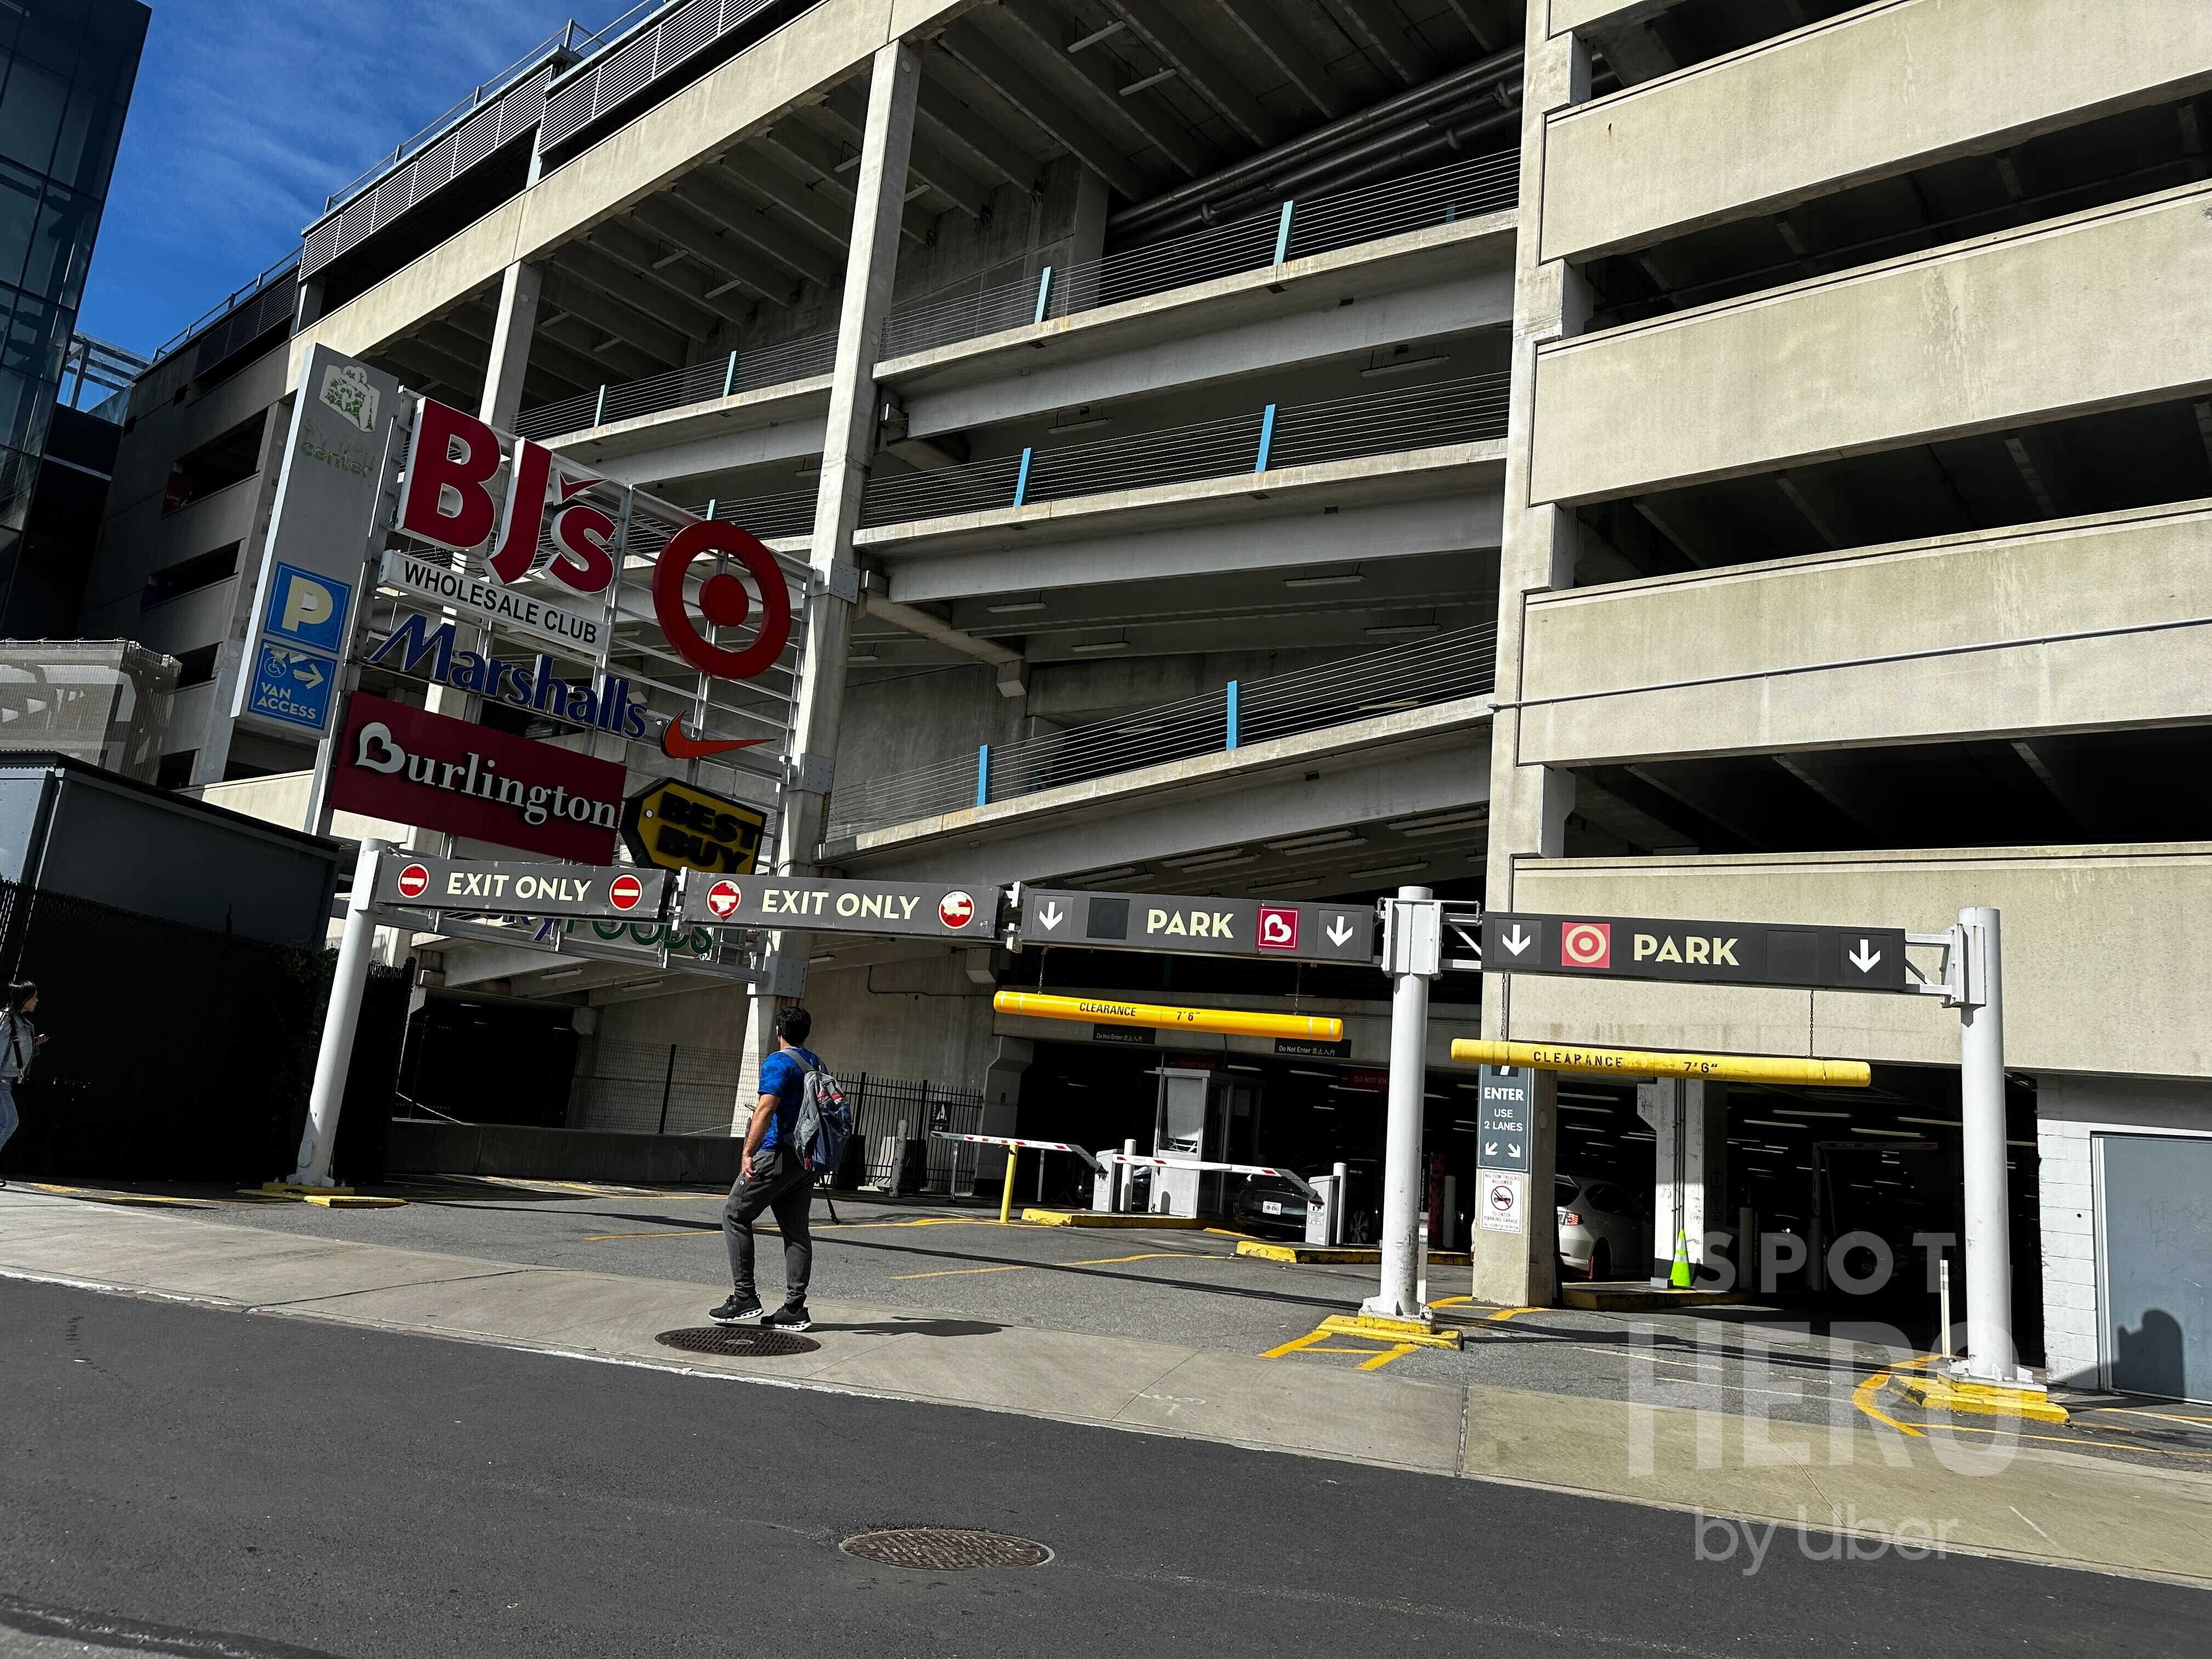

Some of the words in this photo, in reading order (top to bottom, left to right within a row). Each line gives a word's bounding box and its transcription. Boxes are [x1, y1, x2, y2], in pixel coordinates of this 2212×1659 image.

[302, 442, 374, 478] center
[281, 575, 333, 632] P
[404, 561, 538, 625] WHOLESALE
[544, 610, 596, 644] CLUB
[261, 681, 291, 700] VAN
[369, 613, 649, 739] Marshalls
[257, 699, 316, 720] ACCESS
[356, 721, 616, 829] Burlington
[658, 791, 762, 850] BEST
[656, 824, 751, 874] BUY
[446, 872, 510, 899] EXIT
[515, 876, 592, 902] ONLY
[762, 889, 829, 915] EXIT
[836, 893, 921, 920] ONLY
[1147, 908, 1234, 939] PARK
[1634, 934, 1740, 967] PARK
[1079, 1002, 1137, 1017] CLEARANCE
[1533, 1051, 1623, 1068] CLEARANCE
[1484, 1087, 1524, 1101] ENTER
[1484, 1120, 1490, 1129] 2
[1492, 1121, 1523, 1132] LANES
[1494, 1108, 1513, 1118] USE
